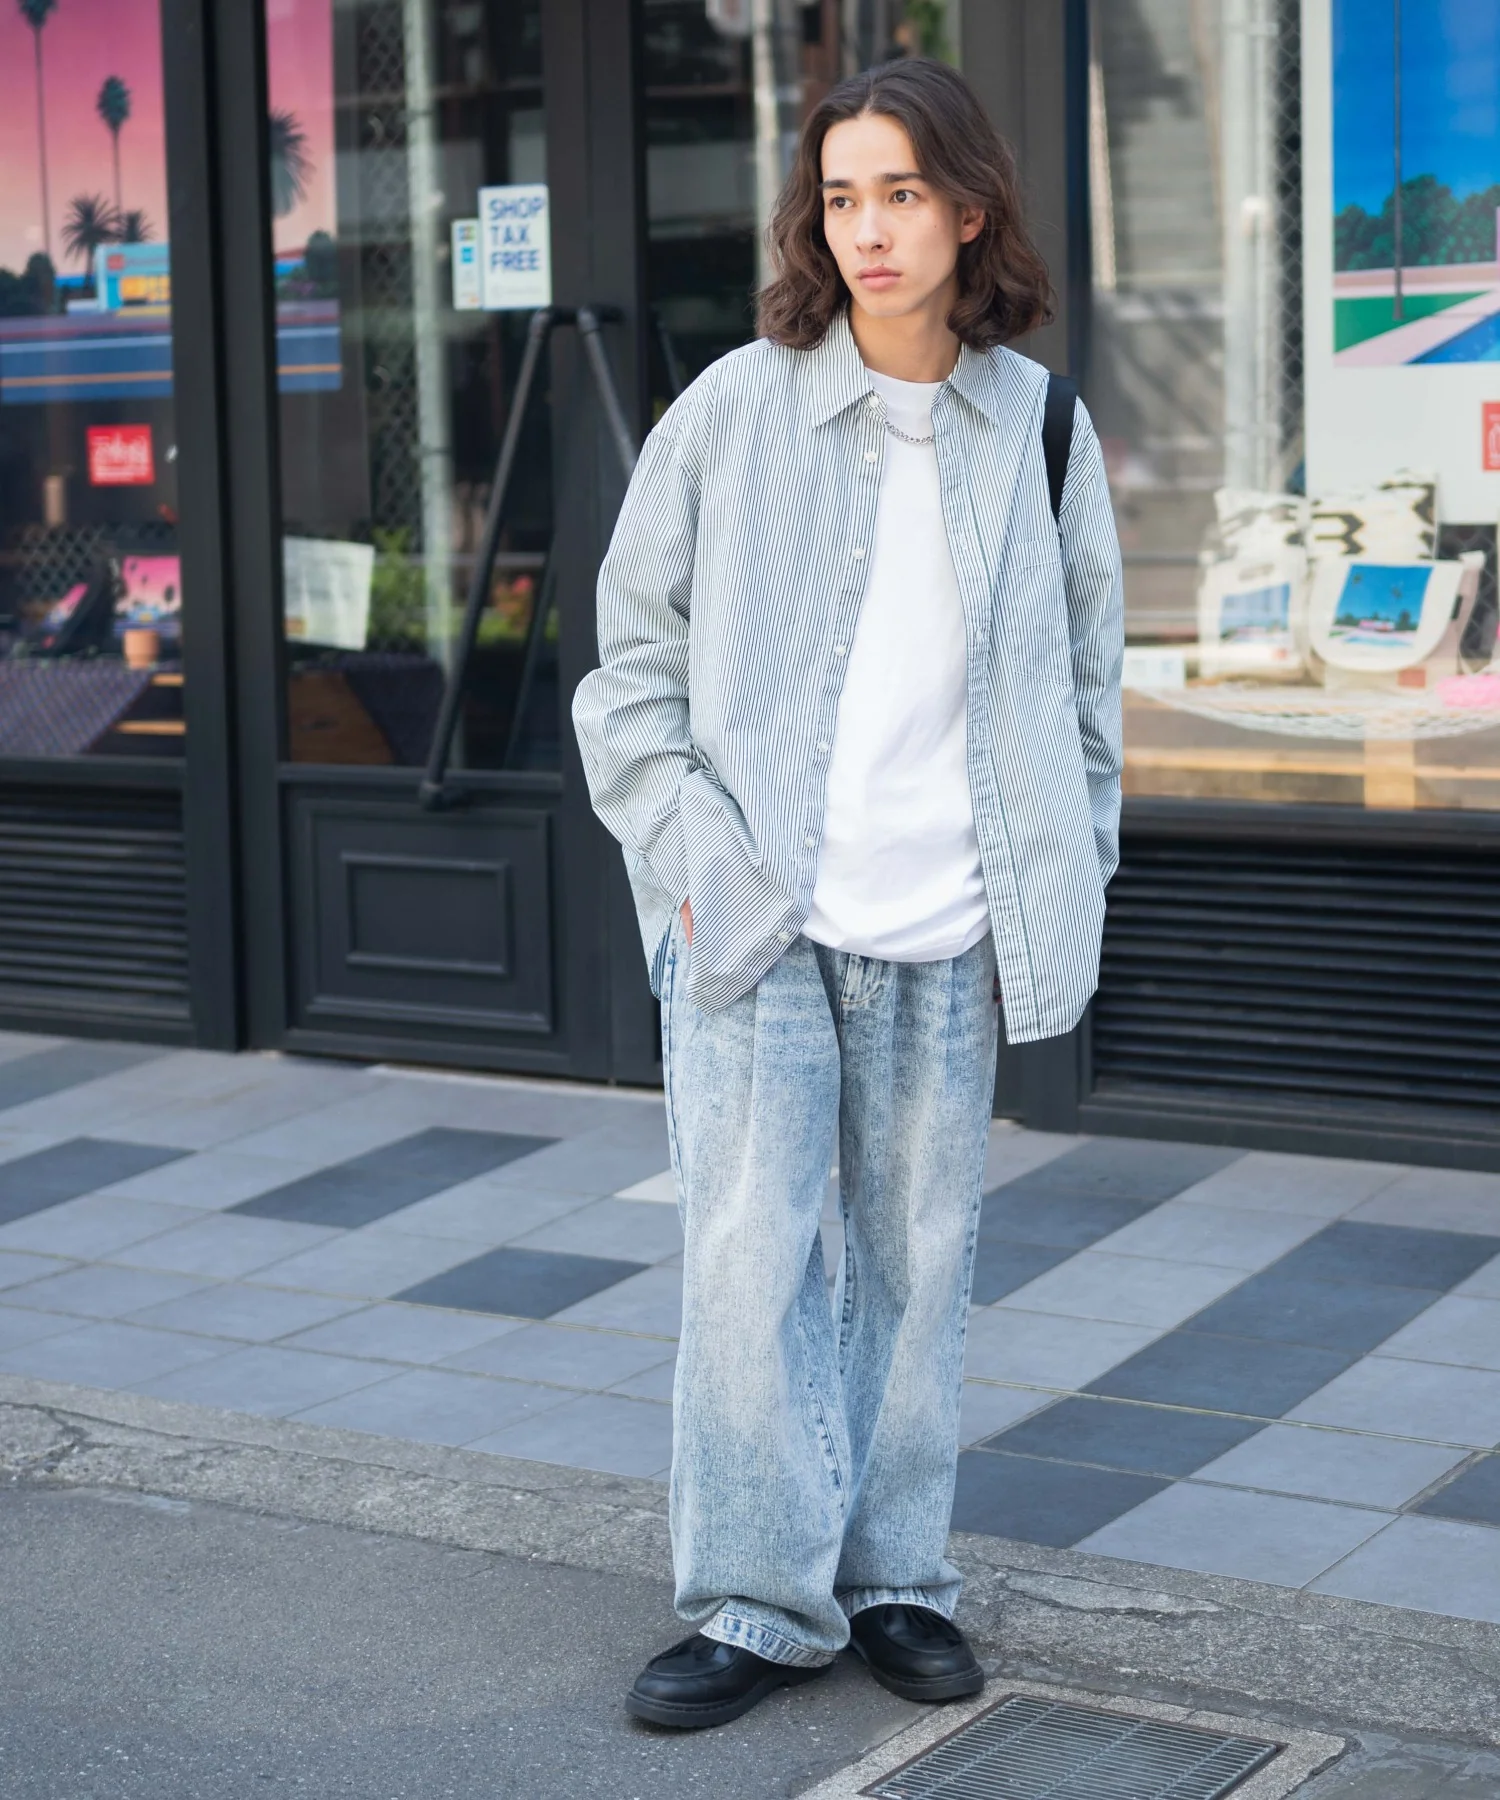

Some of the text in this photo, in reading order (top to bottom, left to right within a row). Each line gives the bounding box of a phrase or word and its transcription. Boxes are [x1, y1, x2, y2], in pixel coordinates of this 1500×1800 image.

[489, 197, 544, 220] SHOP
[490, 224, 530, 245] TAX
[490, 249, 539, 271] FREE
